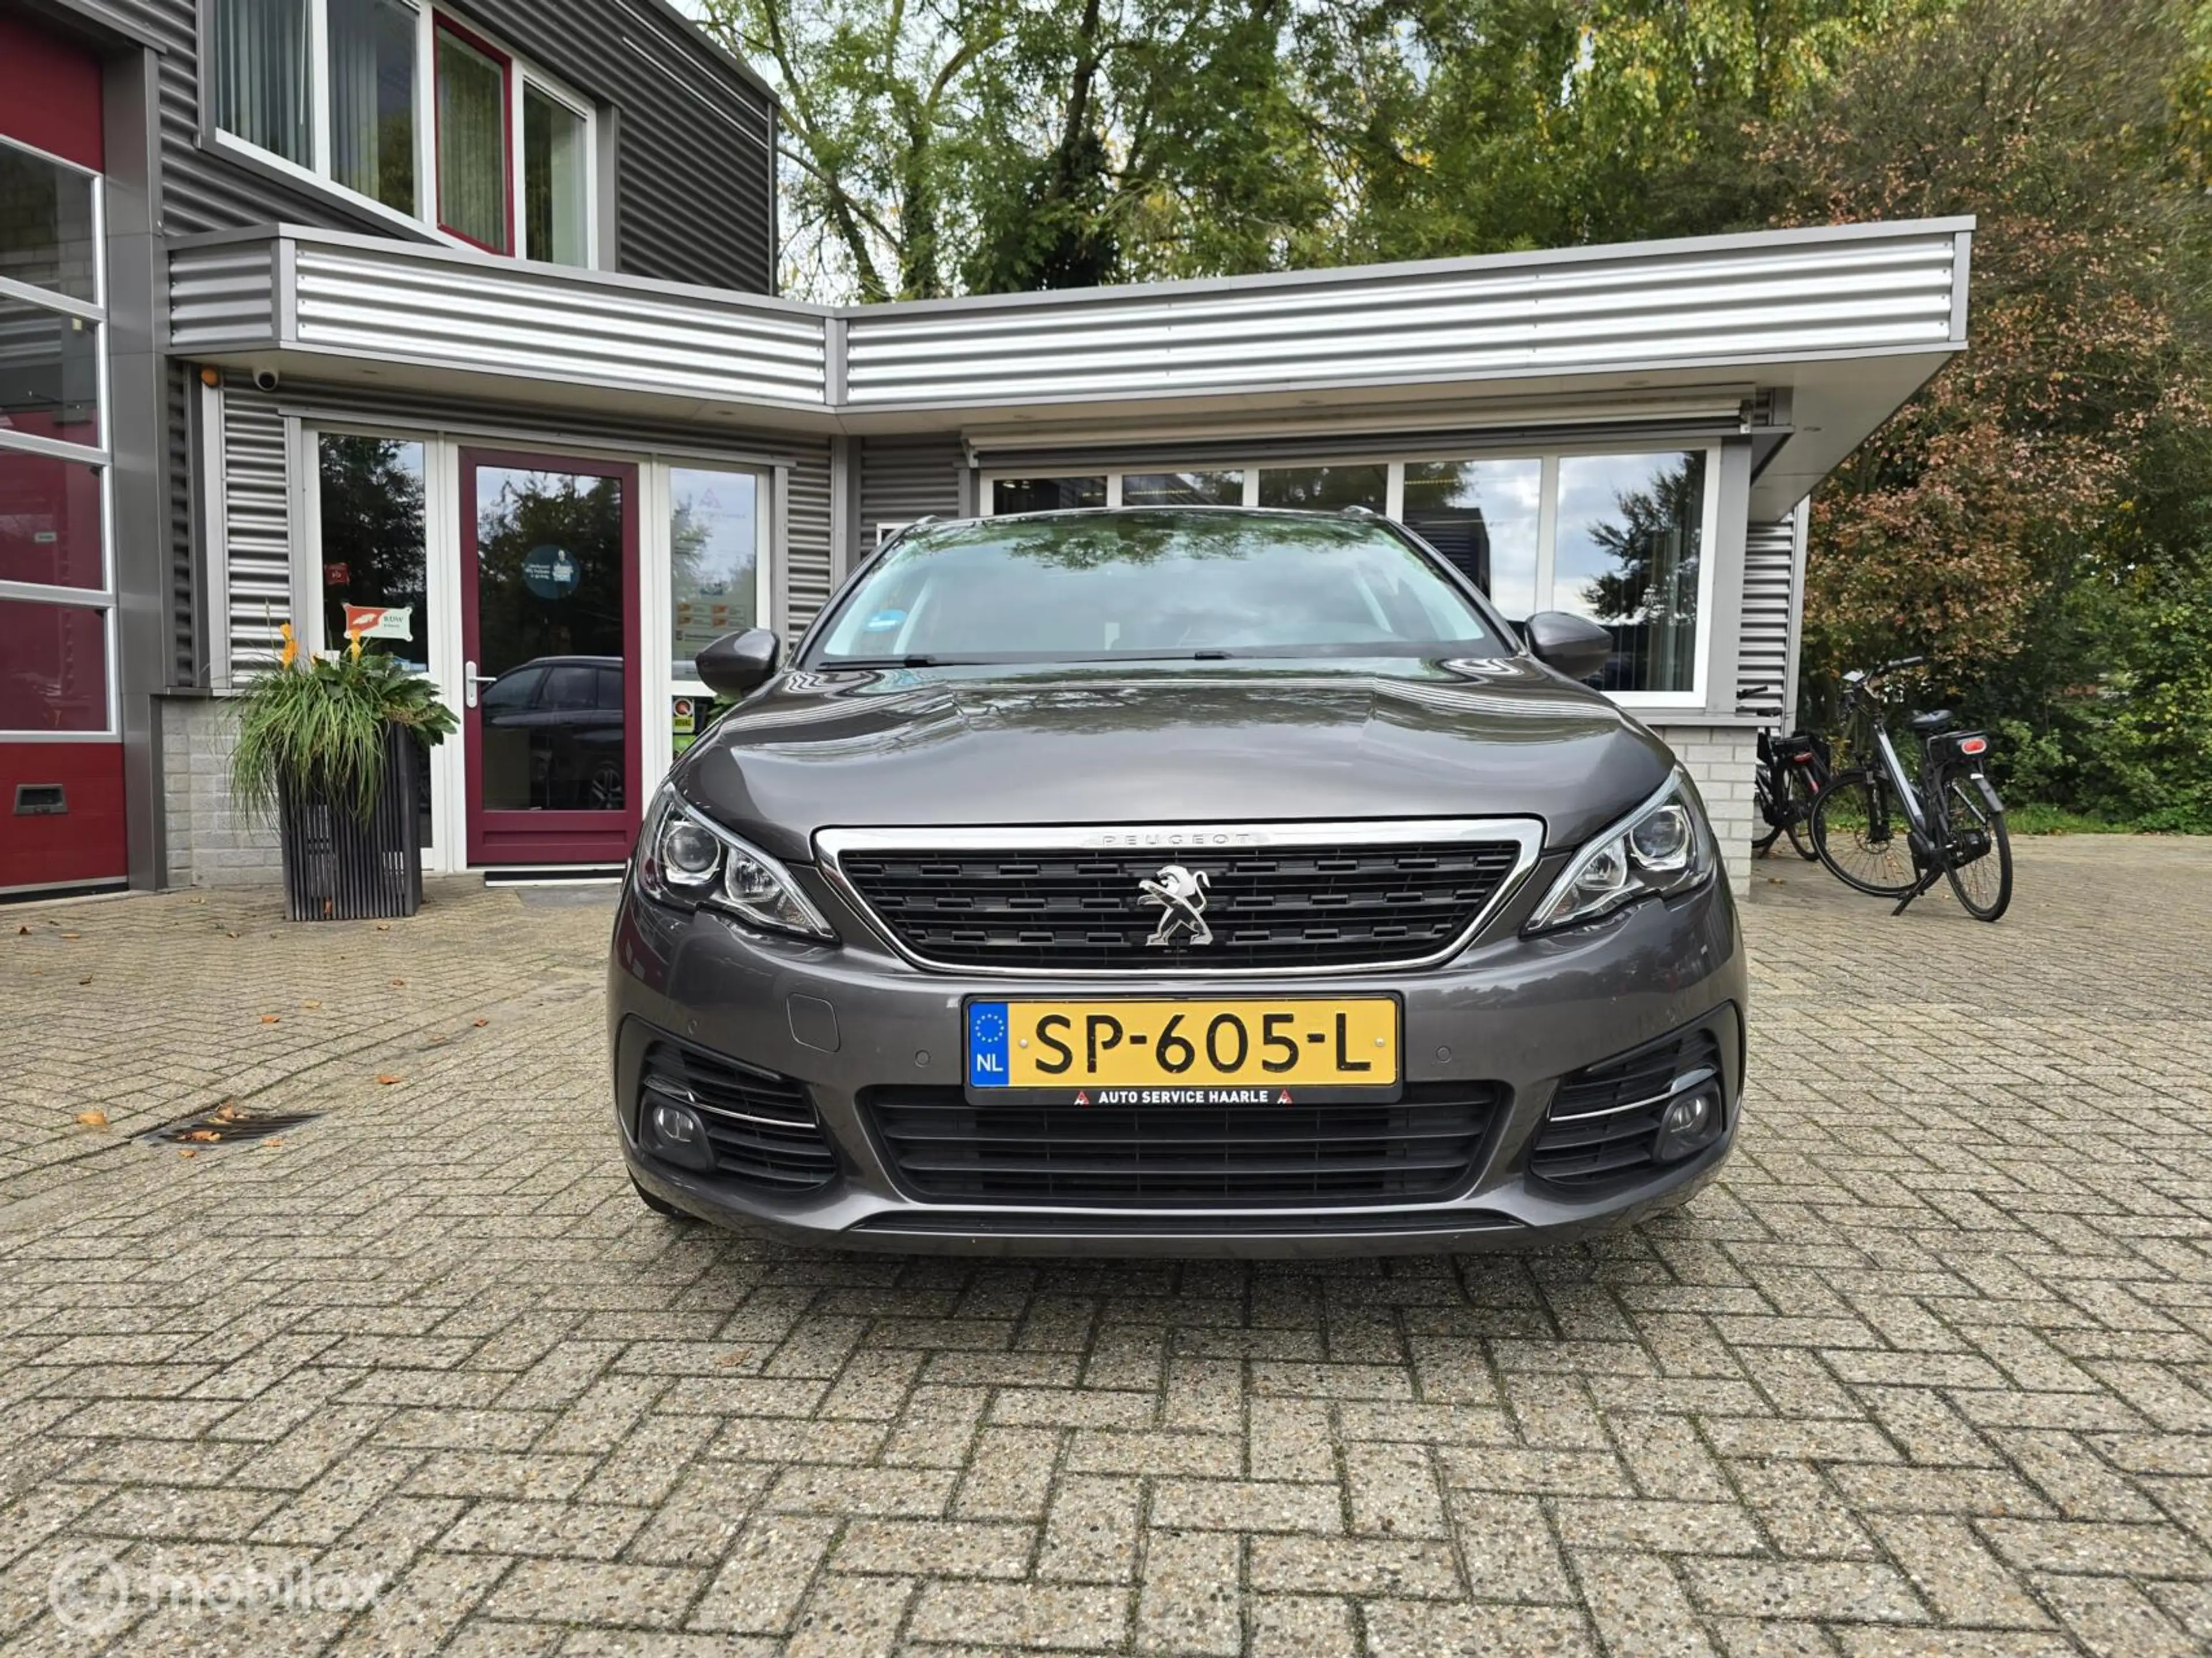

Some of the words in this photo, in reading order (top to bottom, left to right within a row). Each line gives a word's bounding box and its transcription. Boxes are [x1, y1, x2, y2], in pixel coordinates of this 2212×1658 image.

[1103, 834, 1249, 847] PEUGEOT
[1035, 1012, 1372, 1075] SP-605-L
[976, 1053, 1003, 1072] NL
[1099, 1091, 1137, 1103] AUTO
[1142, 1090, 1205, 1103] SERVICE
[1209, 1090, 1268, 1103] HAARLE
